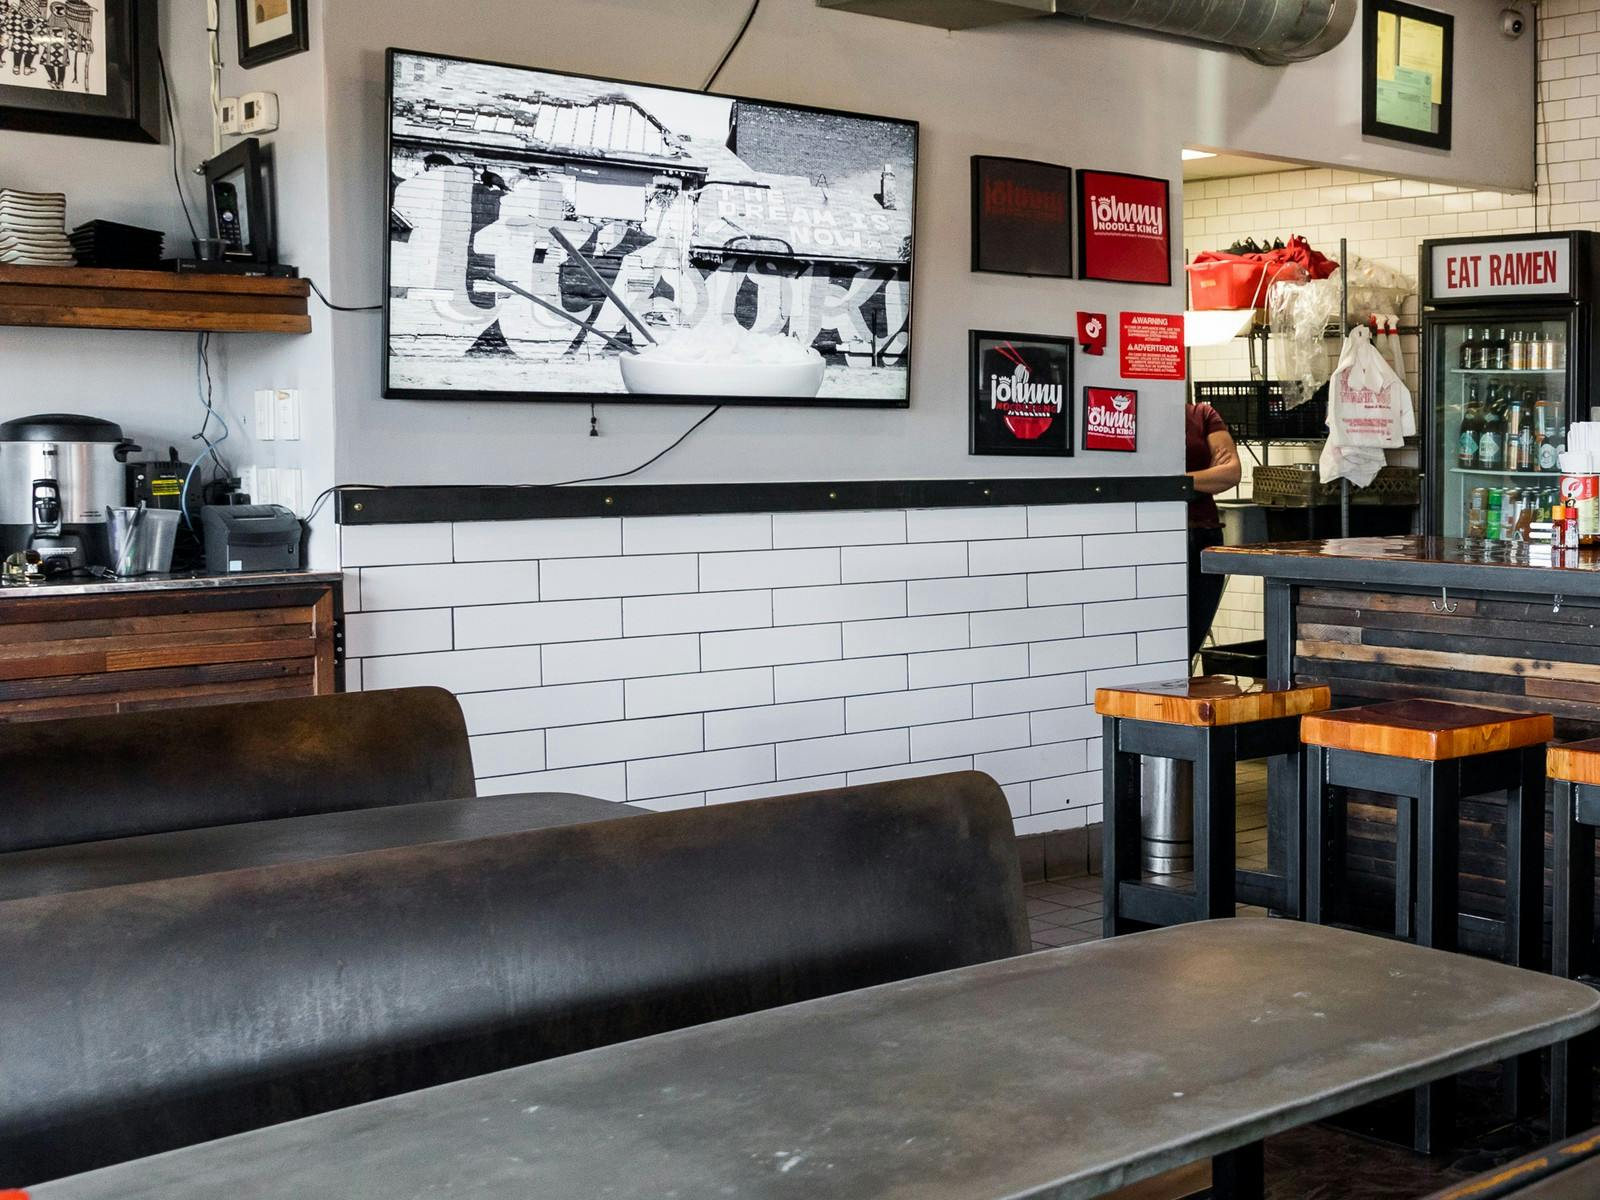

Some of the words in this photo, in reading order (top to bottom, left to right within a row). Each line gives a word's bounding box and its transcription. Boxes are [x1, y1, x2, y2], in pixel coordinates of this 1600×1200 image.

[716, 187, 785, 202] THE
[717, 201, 836, 226] DREAM
[850, 213, 890, 231] IS
[1090, 195, 1163, 235] johnny
[1099, 222, 1135, 232] NOODLE
[1136, 224, 1158, 235] KING
[1447, 256, 1482, 289] EAT
[1489, 250, 1557, 286] RAMEN
[1137, 316, 1168, 325] WARNING
[1134, 344, 1179, 353] ADVERTENCIA
[991, 374, 1062, 413] johnny
[1088, 424, 1115, 434] NOODLE
